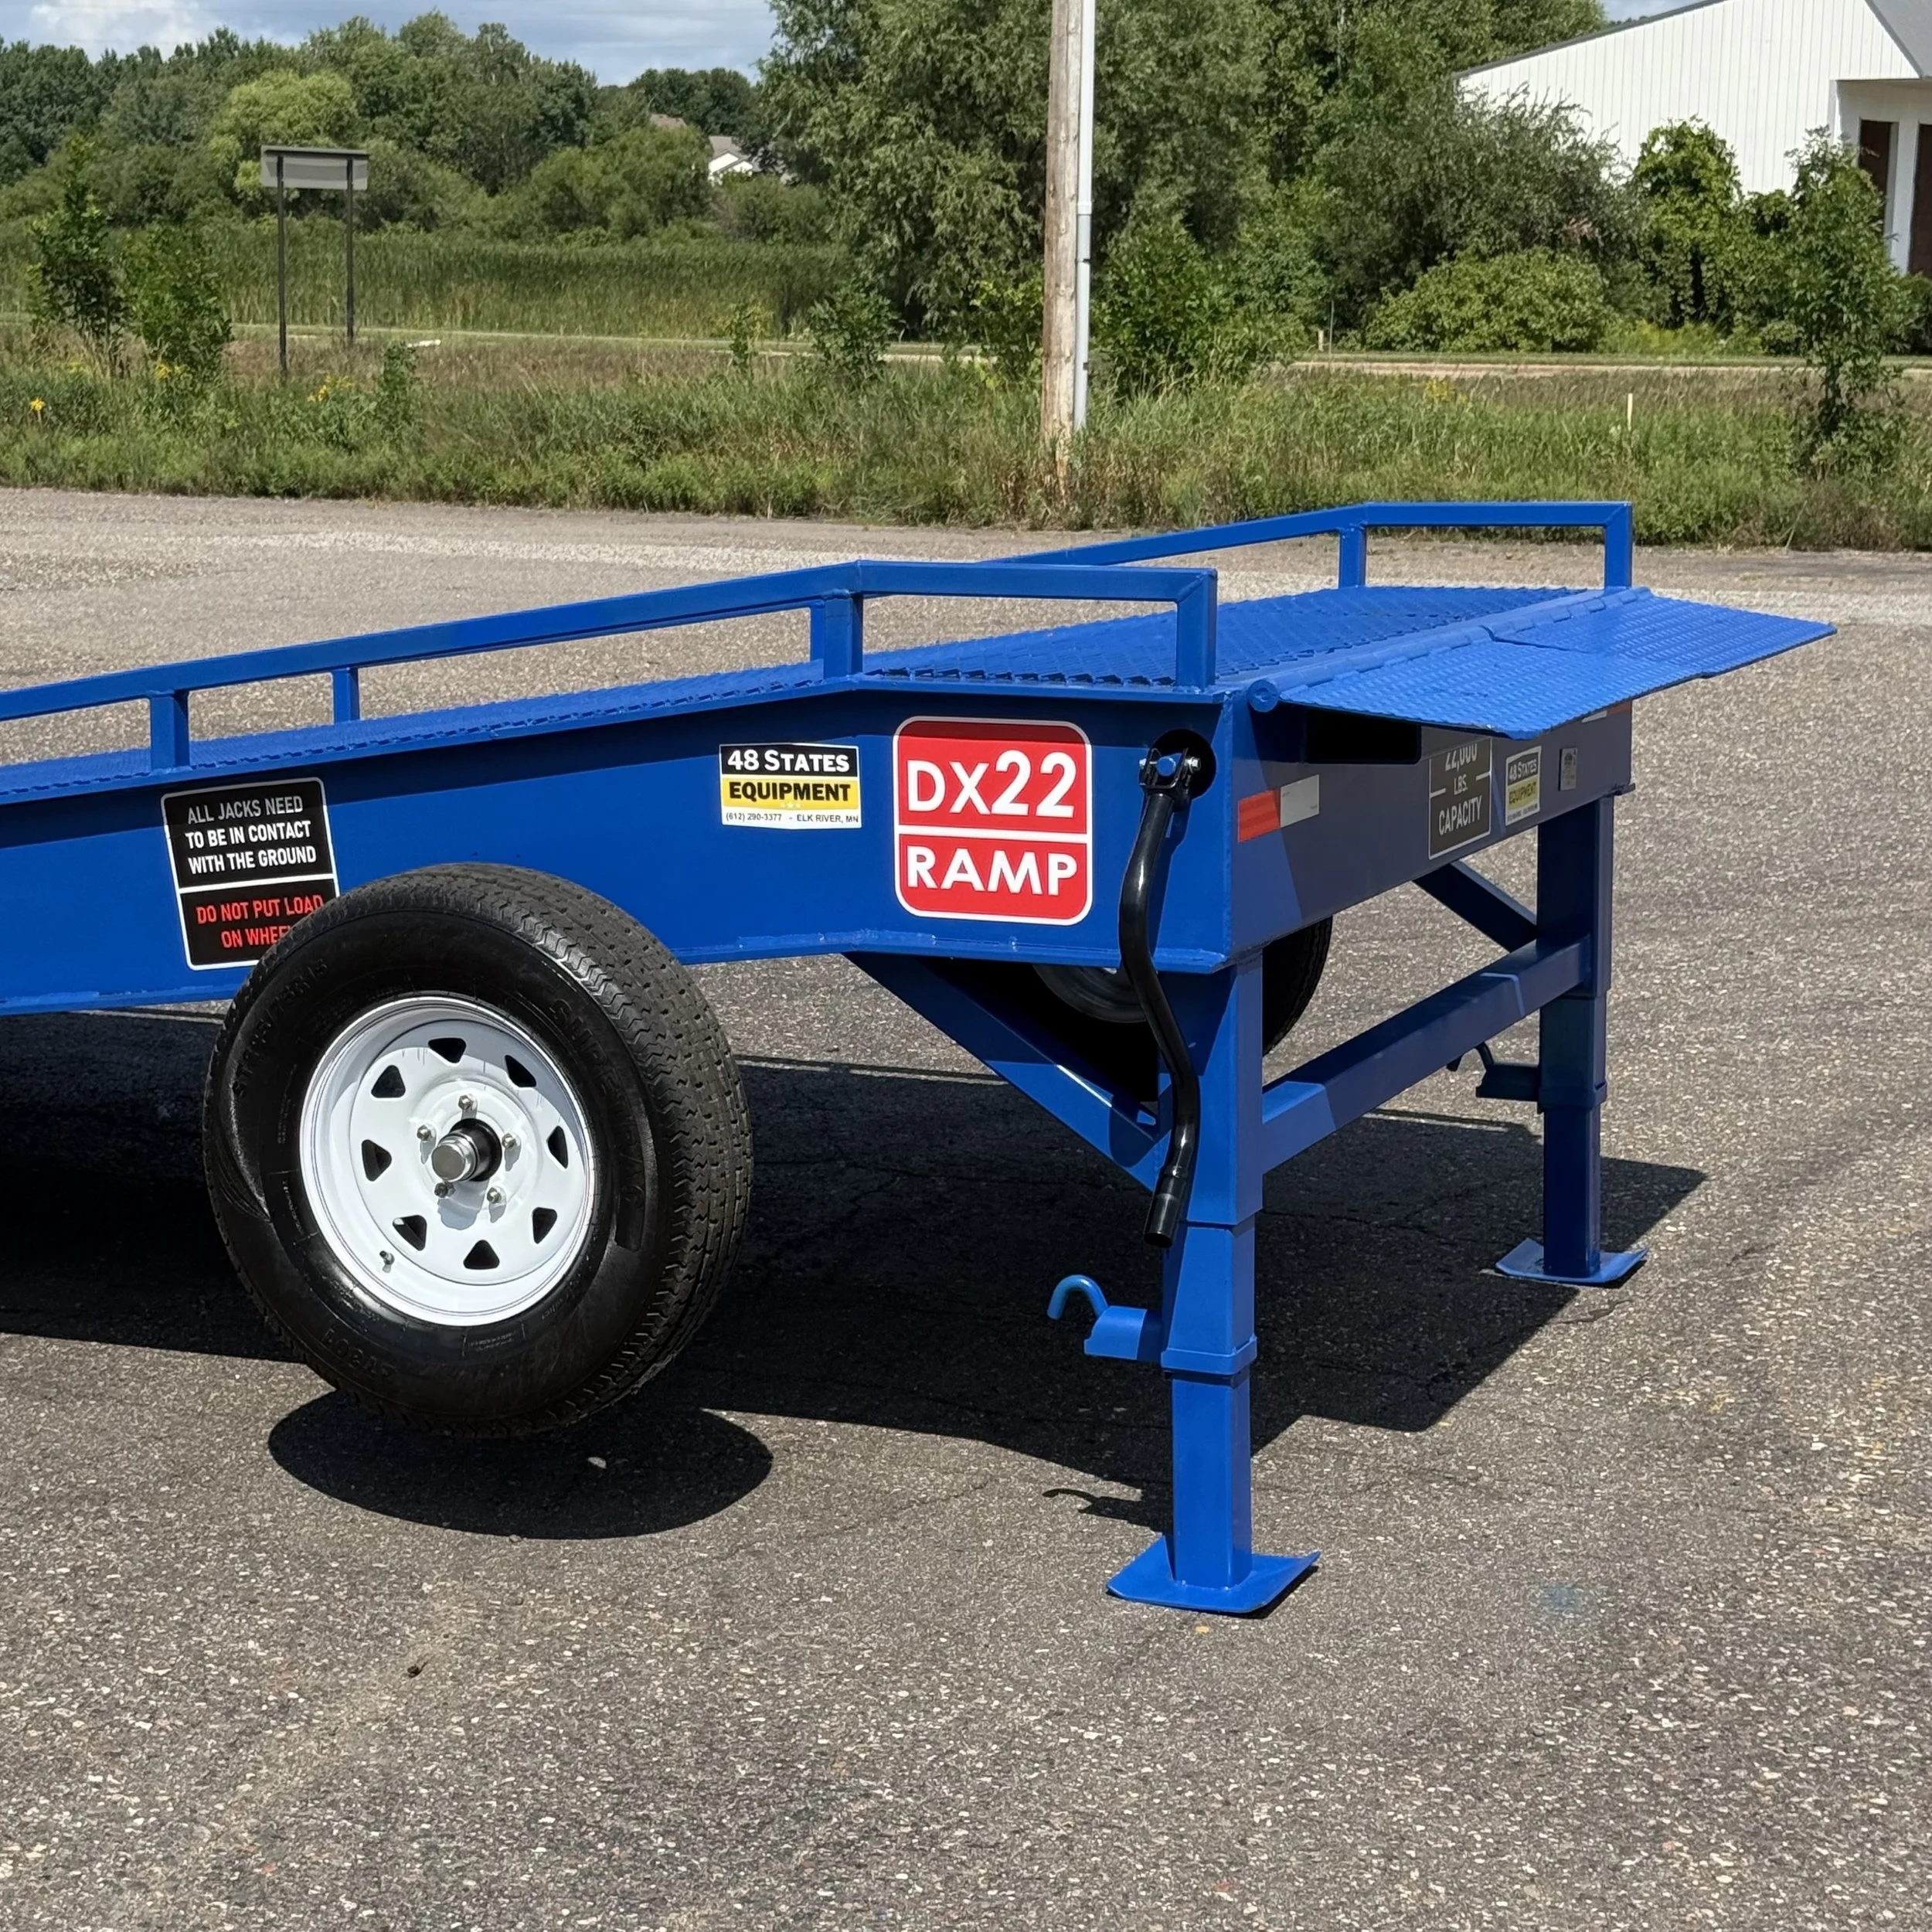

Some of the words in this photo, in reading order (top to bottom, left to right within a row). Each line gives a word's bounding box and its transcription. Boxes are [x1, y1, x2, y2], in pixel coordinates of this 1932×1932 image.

[727, 750, 760, 770] 48
[764, 750, 850, 773] STATES
[1509, 764, 1518, 782] 48
[729, 781, 850, 802] EQUIPMENT
[906, 750, 1077, 818] DX22
[188, 805, 215, 825] ALL
[218, 799, 261, 820] JACKS
[265, 796, 303, 815] NEED
[726, 812, 745, 822] (612)
[797, 814, 814, 822] ELK
[815, 815, 844, 824] RIVER,
[845, 815, 859, 823] MN
[1438, 794, 1482, 836] CAPACITY
[185, 832, 204, 849] TO
[207, 828, 227, 847] BE
[230, 827, 245, 845] IN
[247, 821, 311, 842] CONTACT
[188, 855, 226, 875] WITH
[226, 851, 256, 871] THE
[258, 845, 317, 867] GROUND
[906, 845, 1077, 896] RAMP
[195, 906, 216, 924] DO
[221, 901, 250, 921] NOT
[252, 899, 281, 920] PUT
[284, 894, 324, 916] LOAD
[220, 929, 243, 949] ON
